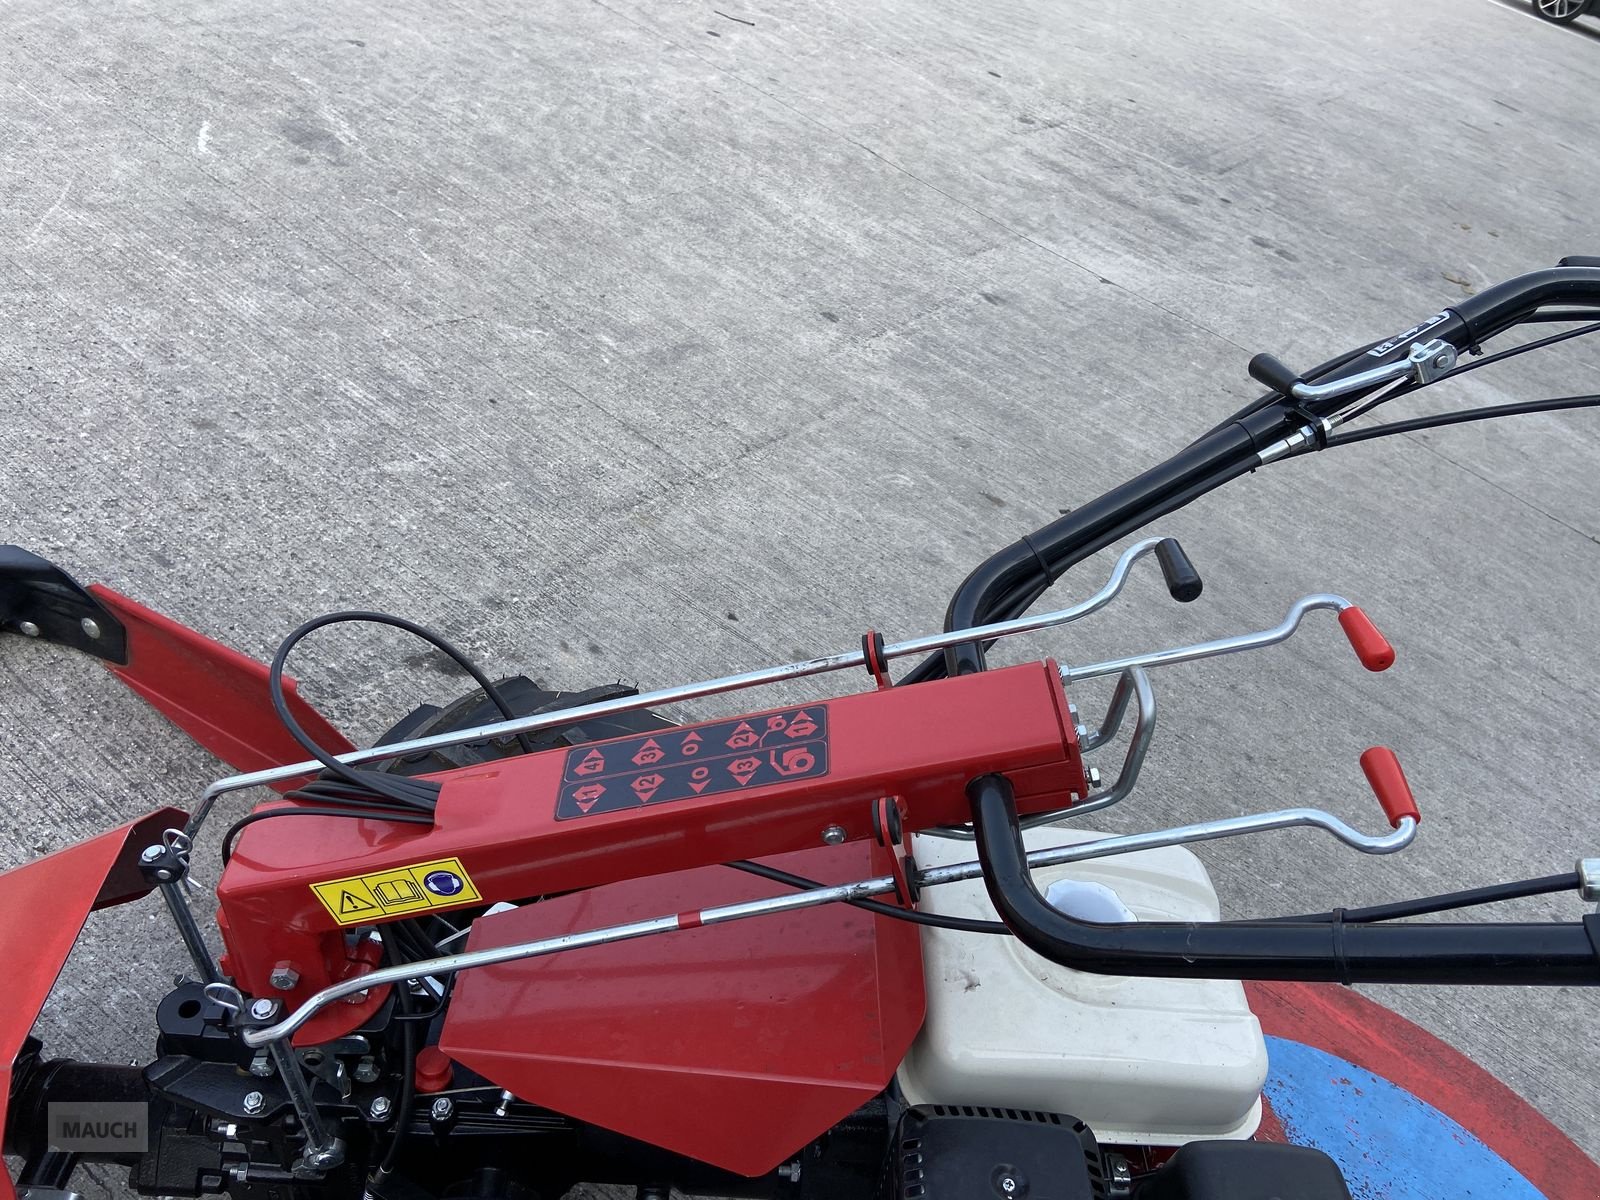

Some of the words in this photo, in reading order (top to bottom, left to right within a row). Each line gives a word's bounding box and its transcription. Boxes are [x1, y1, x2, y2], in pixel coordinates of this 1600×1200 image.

[733, 735, 749, 744] 2
[640, 752, 656, 761] 3
[737, 760, 753, 769] 3
[639, 777, 655, 786] 2
